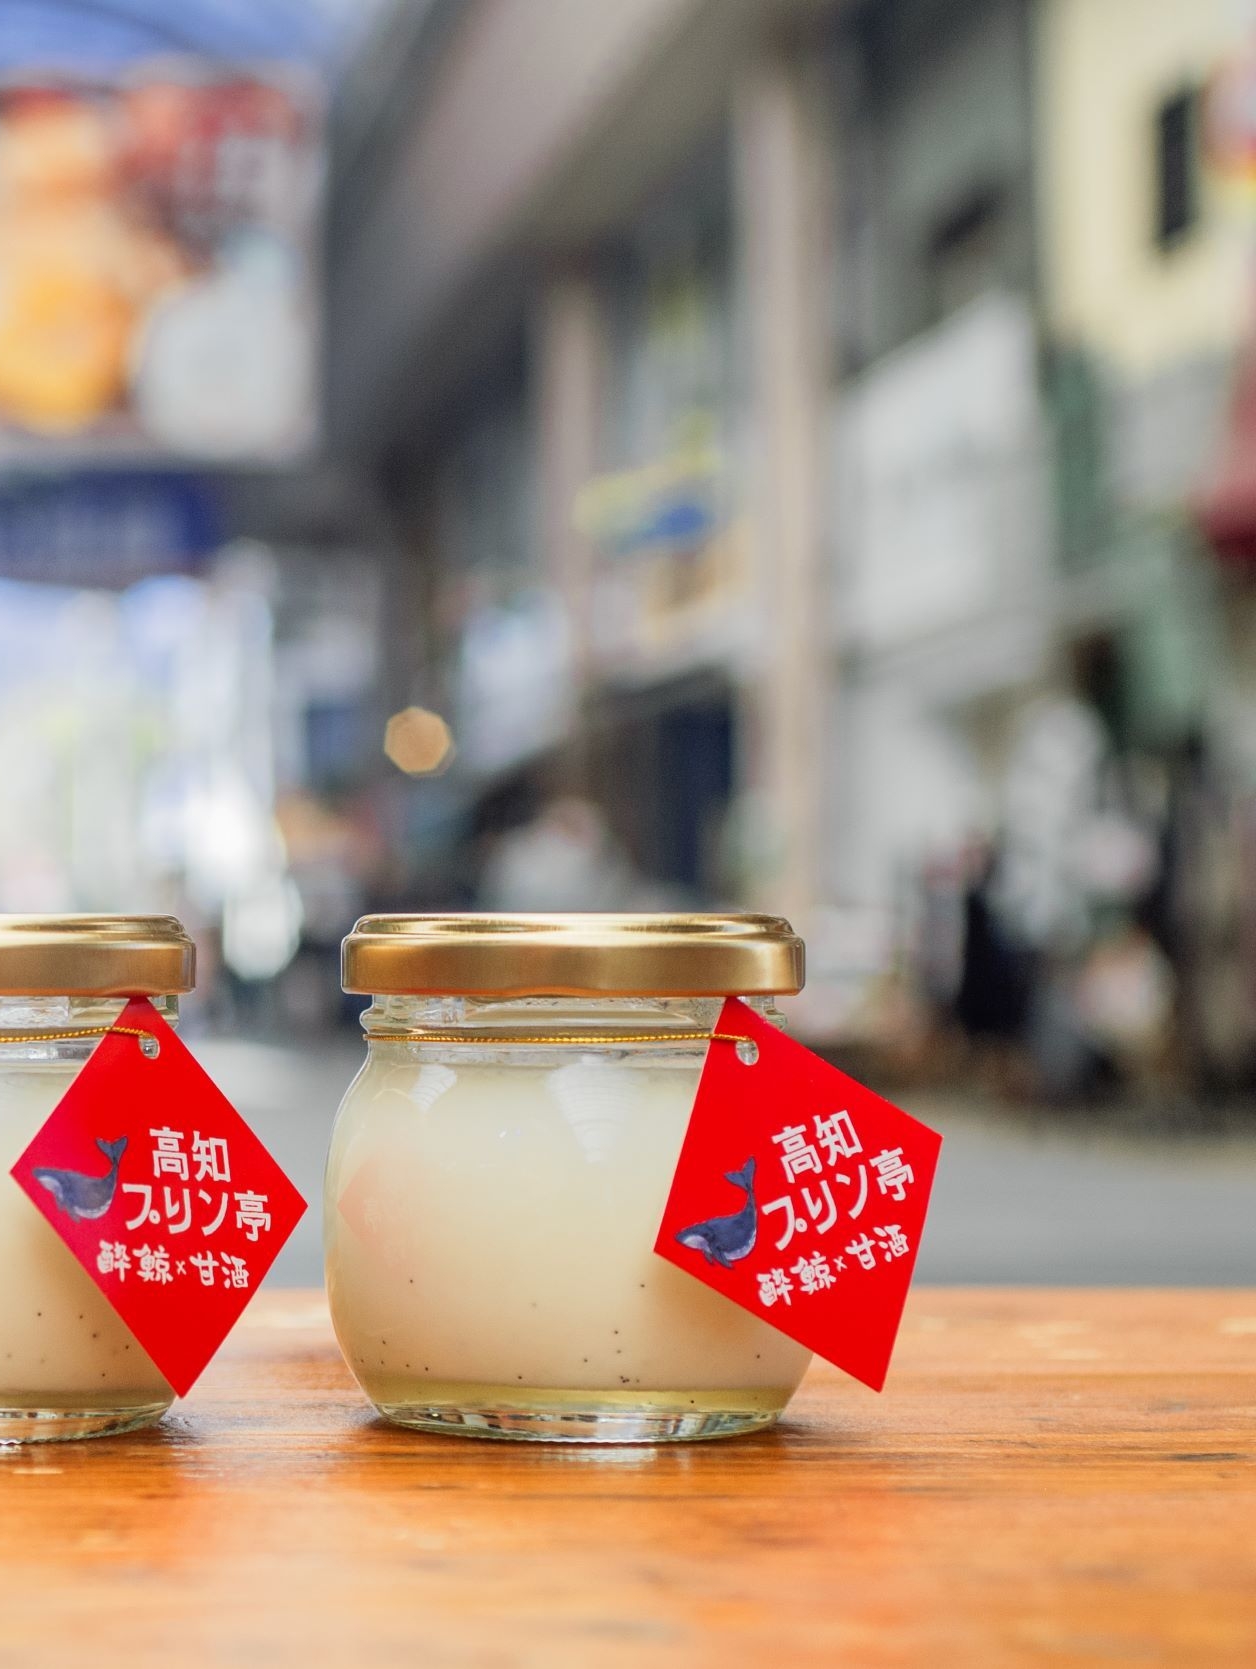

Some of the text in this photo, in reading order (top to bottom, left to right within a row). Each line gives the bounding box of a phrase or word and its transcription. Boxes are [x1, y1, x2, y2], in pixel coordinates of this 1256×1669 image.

[149, 1126, 231, 1182] 高知
[771, 1110, 863, 1184] 高知
[122, 1183, 271, 1241] プリン亭
[761, 1147, 914, 1251] プリン亭
